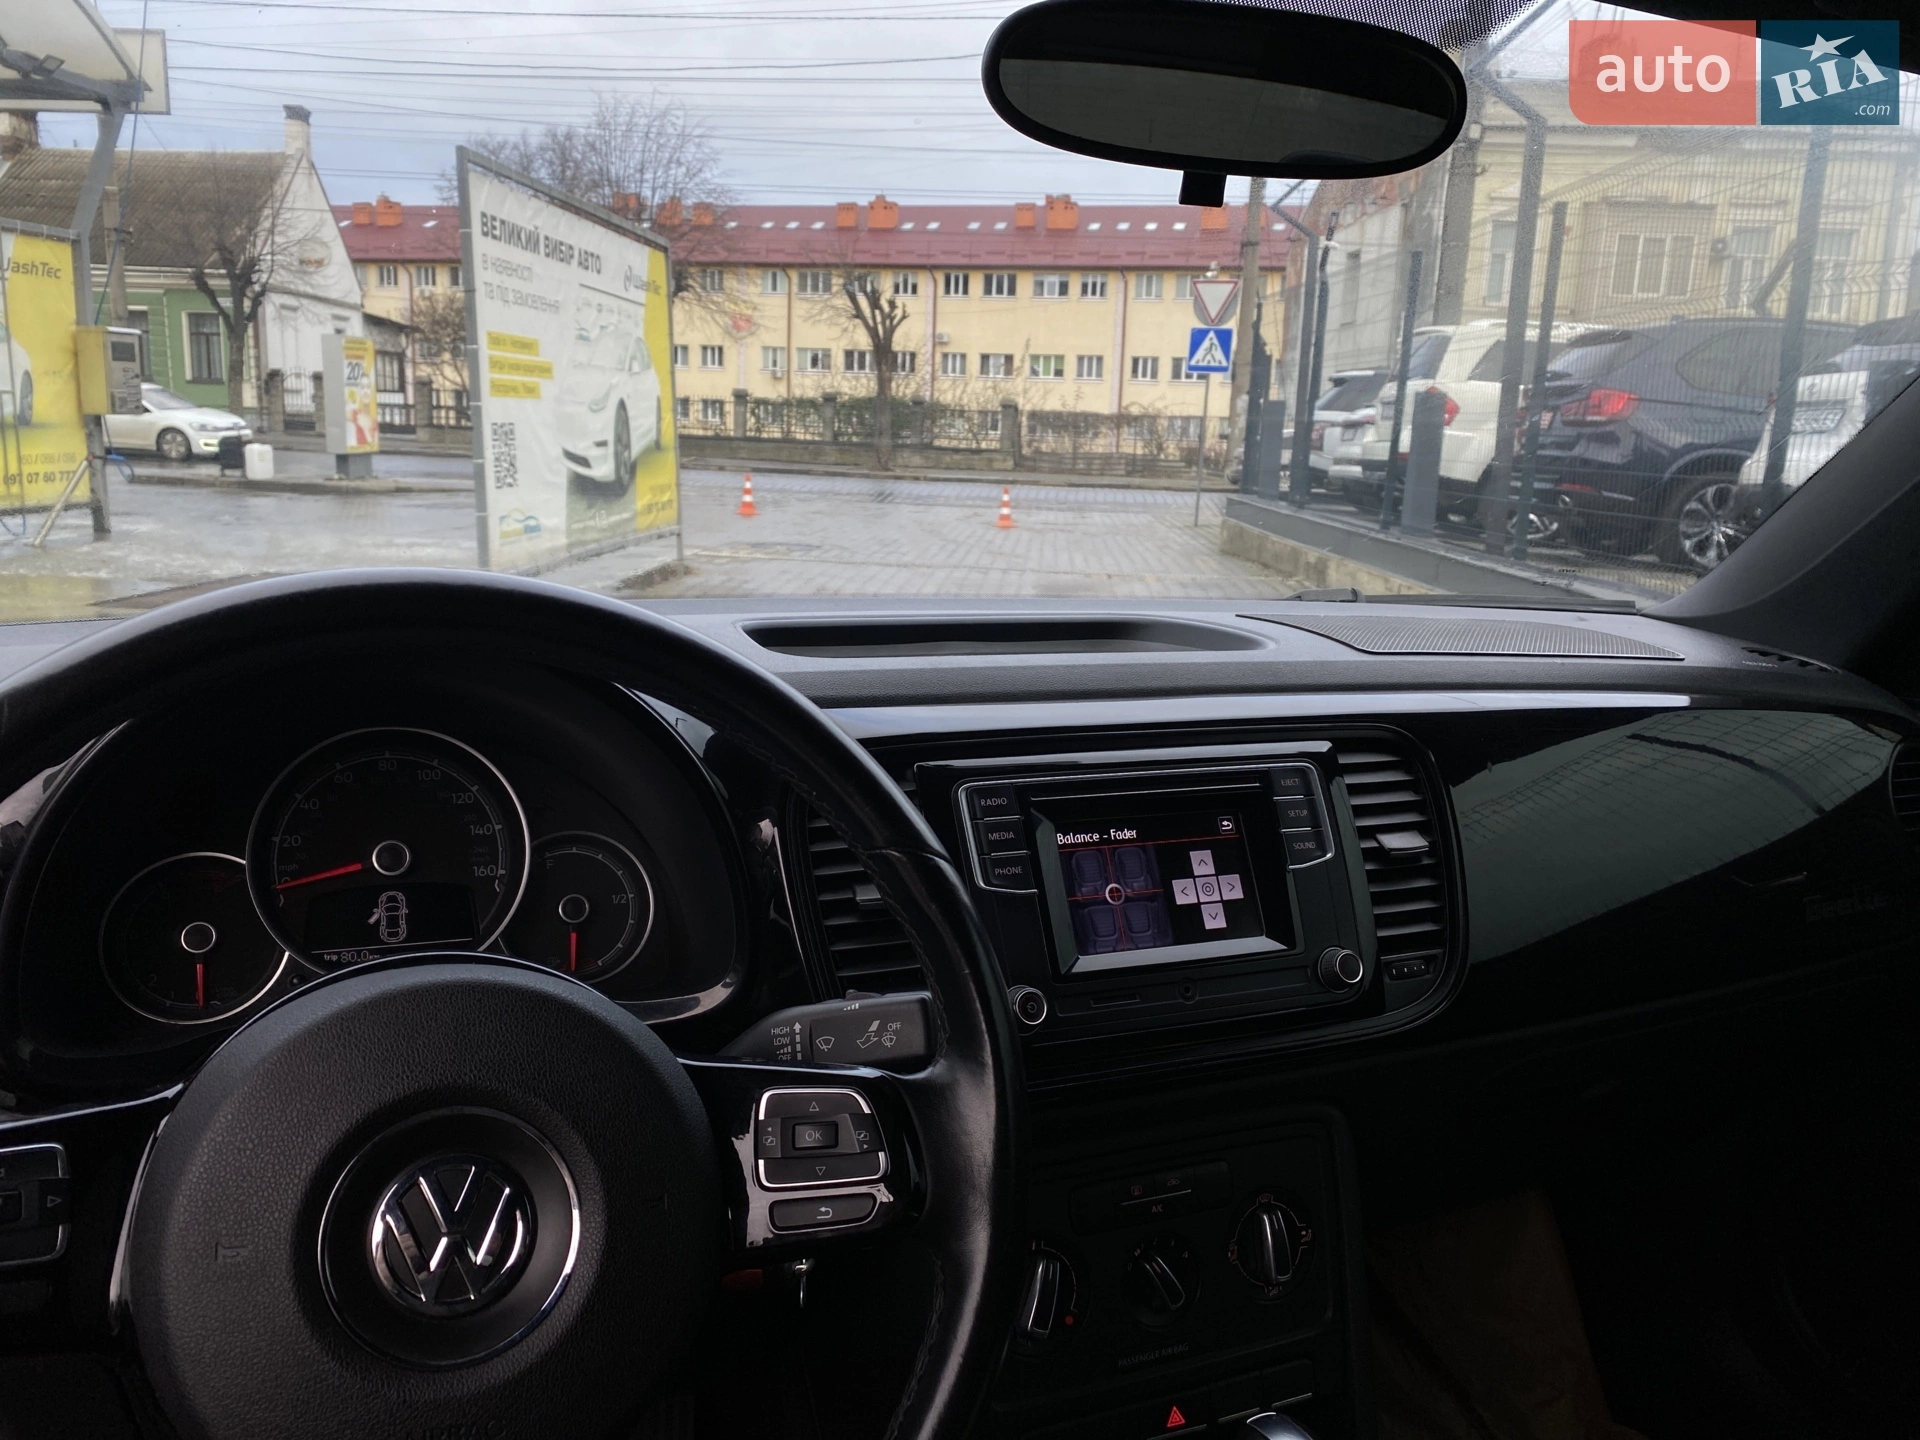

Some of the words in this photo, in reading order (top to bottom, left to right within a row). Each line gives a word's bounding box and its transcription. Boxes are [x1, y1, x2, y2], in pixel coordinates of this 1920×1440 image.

[480, 211, 540, 256] ВЕЛИКИЙ
[543, 234, 575, 265] ВИБІР
[577, 247, 602, 275] АВТО
[26, 472, 40, 484] 07
[378, 760, 397, 771] 80
[333, 771, 353, 783] 60
[416, 769, 441, 781] 100
[1280, 777, 1300, 788] EJECT
[299, 798, 319, 810] 40
[450, 792, 475, 804] 120
[980, 796, 1008, 807] RADIO
[1287, 809, 1309, 819] SETUP
[470, 823, 493, 836] 140
[282, 834, 302, 847] 20
[988, 830, 1015, 842] MEDIA
[1056, 830, 1101, 845] Balance
[1110, 827, 1138, 841] Fader
[1293, 840, 1318, 851] SOUND
[278, 863, 299, 872] mph
[472, 864, 497, 877] 160
[546, 859, 555, 870] F
[994, 865, 1023, 877] PHONE
[611, 893, 627, 904] 1/2
[323, 953, 338, 962] trip
[340, 950, 369, 963] 80.0
[771, 1026, 790, 1036] HIGH
[887, 1021, 902, 1031] OFF
[773, 1036, 791, 1046] LOW
[805, 1130, 823, 1142] OK
[1118, 1350, 1160, 1367] PASSENGER
